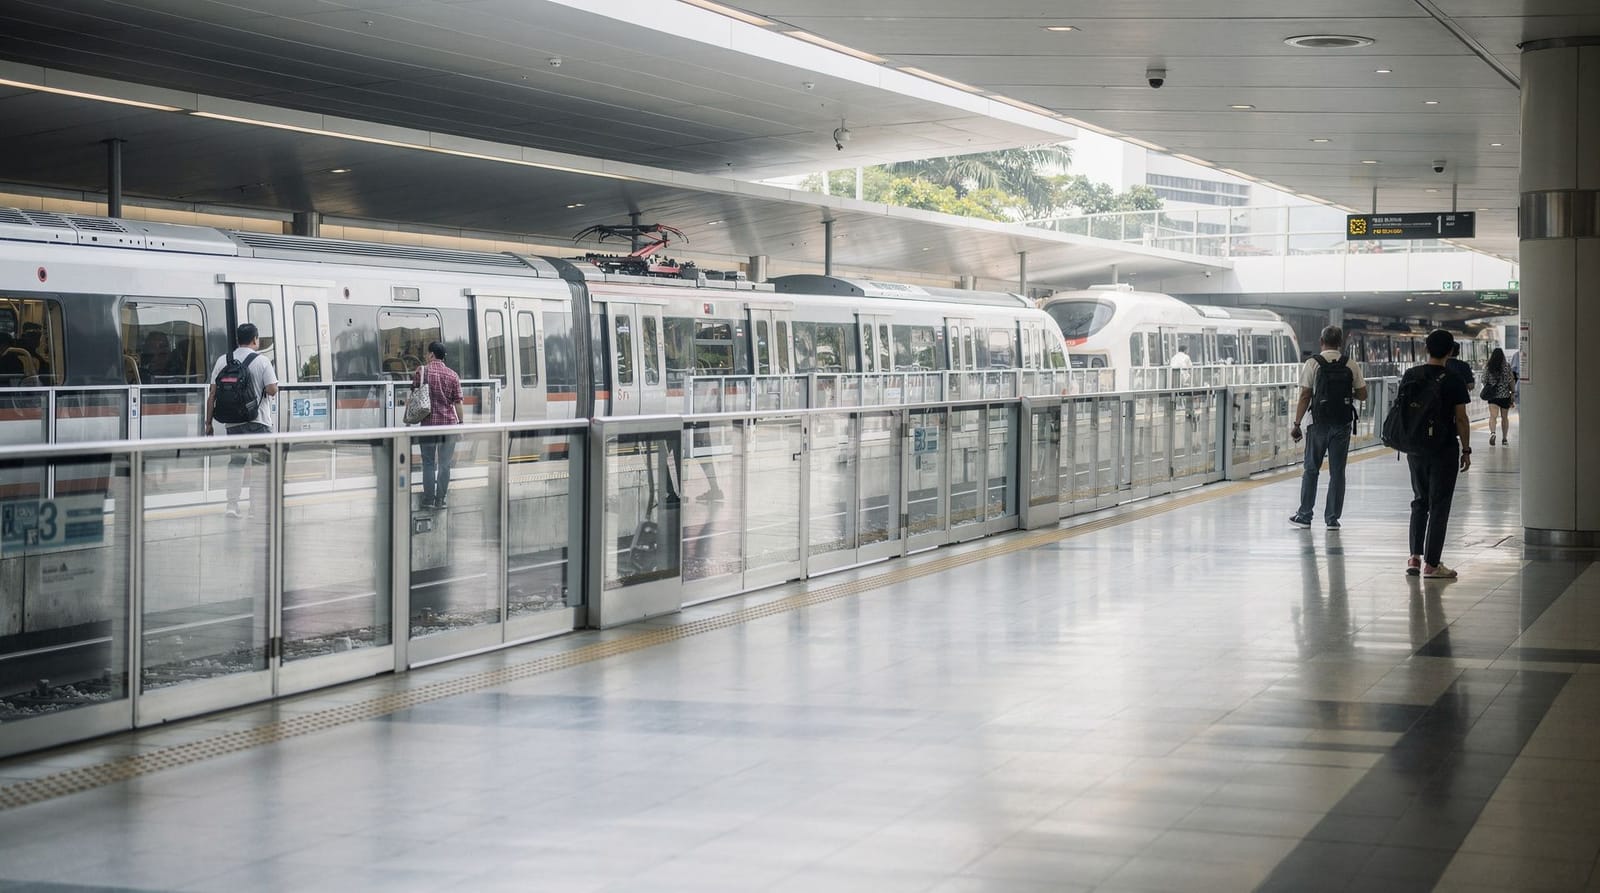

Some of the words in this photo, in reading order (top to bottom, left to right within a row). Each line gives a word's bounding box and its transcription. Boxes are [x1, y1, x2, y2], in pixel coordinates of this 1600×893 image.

[1437, 215, 1442, 234] 1
[304, 400, 311, 416] 3
[40, 502, 57, 540] 3
